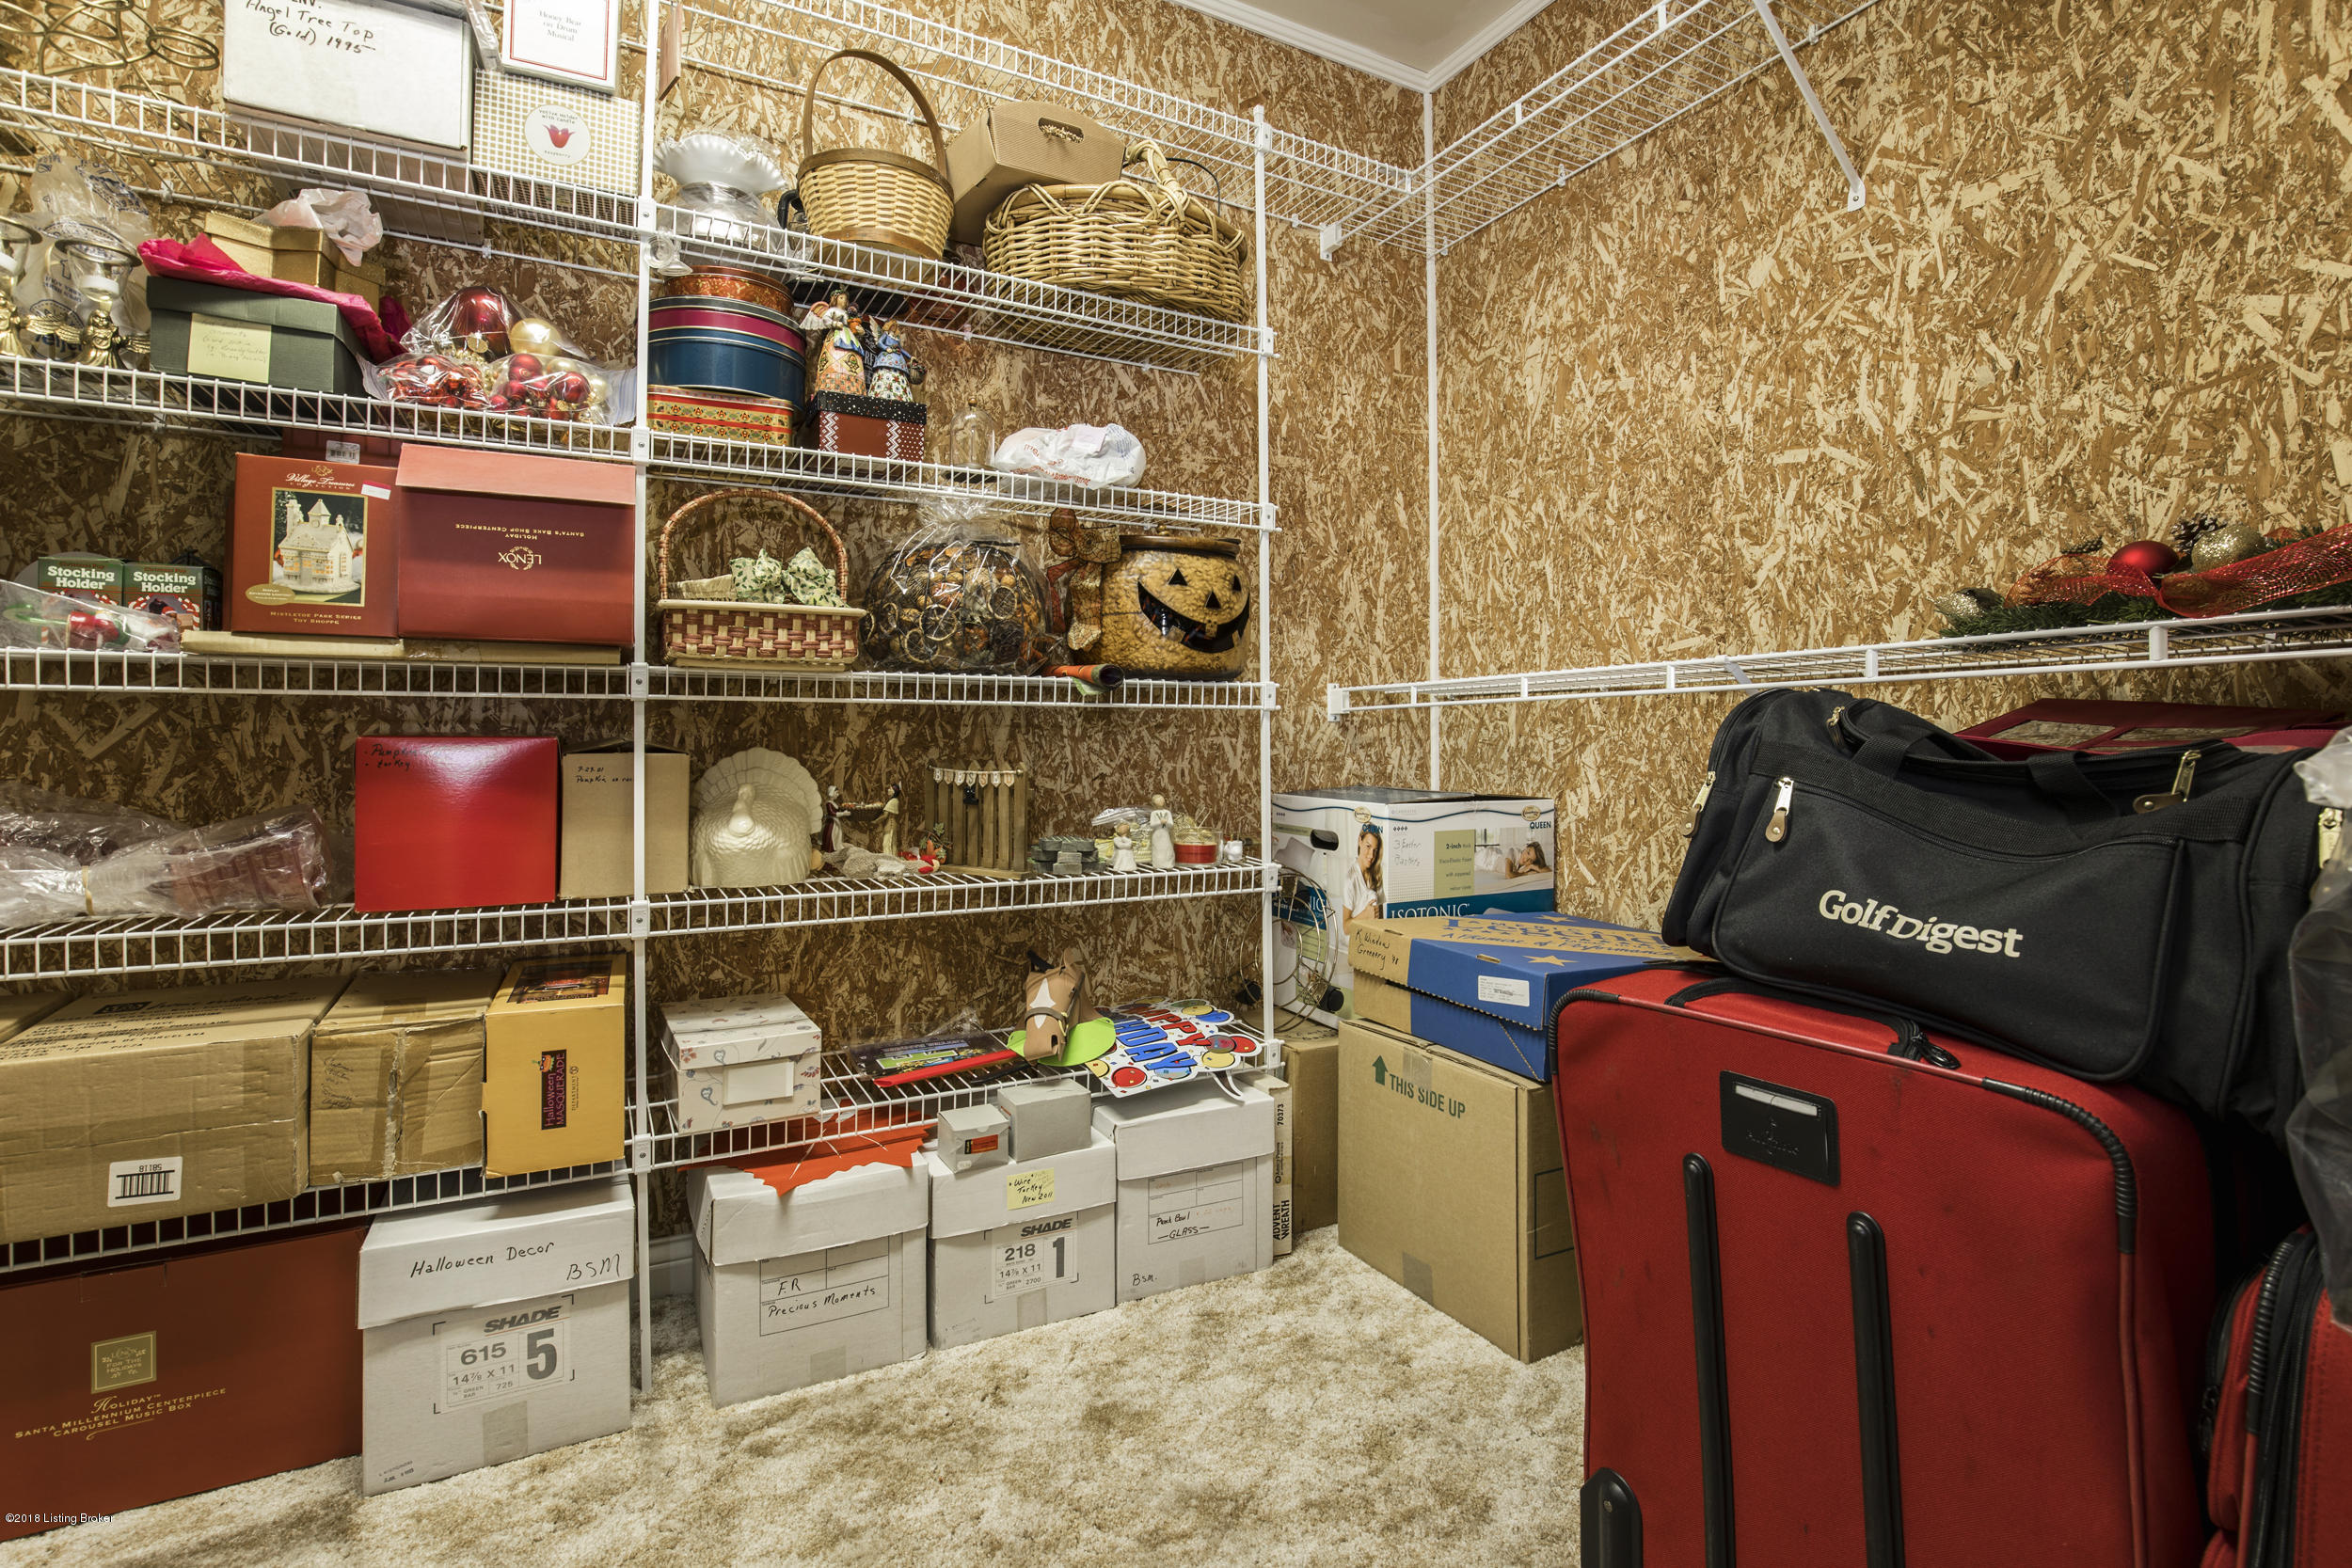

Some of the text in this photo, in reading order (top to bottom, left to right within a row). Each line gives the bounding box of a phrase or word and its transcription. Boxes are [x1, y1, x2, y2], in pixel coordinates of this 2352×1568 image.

[246, 0, 290, 22] Angel
[297, 10, 332, 28] Tree
[539, 10, 581, 26] Honey Bear
[269, 22, 376, 54] (Gold) 1995
[547, 29, 575, 42] Musical
[557, 24, 578, 34] Drum
[285, 472, 356, 488] Village Treasures
[455, 523, 508, 532] CENTERPIECE
[554, 530, 585, 538] SANTA'S
[497, 551, 542, 565] LENOX
[47, 565, 116, 582] Stocking
[134, 571, 197, 586] Stocking
[56, 577, 106, 590] Holder
[141, 581, 188, 594] Holder
[933, 768, 1014, 786] BLESSED
[1530, 820, 1551, 830] QUEEN
[1355, 928, 1391, 949] K Window
[1358, 943, 1387, 971] Greenery
[556, 1053, 565, 1125] MASQUERADE
[1389, 1073, 1466, 1119] THIS SIDE UP
[543, 1072, 556, 1127] Halloween
[1276, 1103, 1285, 1127] 70373
[138, 1164, 163, 1173] 58118
[1022, 1192, 1054, 1204] New 2011
[1020, 1218, 1073, 1238] SHADE
[1273, 1204, 1281, 1241] ADVENT
[1280, 1199, 1290, 1240] WREATH
[410, 1242, 555, 1278] Halloween Decor
[1004, 1236, 1065, 1278] 218 1
[565, 1253, 621, 1281] BSM
[1030, 1263, 1041, 1272] 11
[1025, 1276, 1041, 1286] 2700
[768, 1284, 876, 1318] Precious Moments
[484, 1306, 563, 1334] SHADE
[460, 1328, 558, 1381] 615 5
[500, 1364, 515, 1375] 11
[463, 1386, 485, 1394] GREEN
[496, 1381, 514, 1390] 725
[14, 1387, 227, 1439] SANTA MILLENNIUM CENTERPIECE
[53, 1402, 193, 1437] CAROUSEL MUSIC BOX
